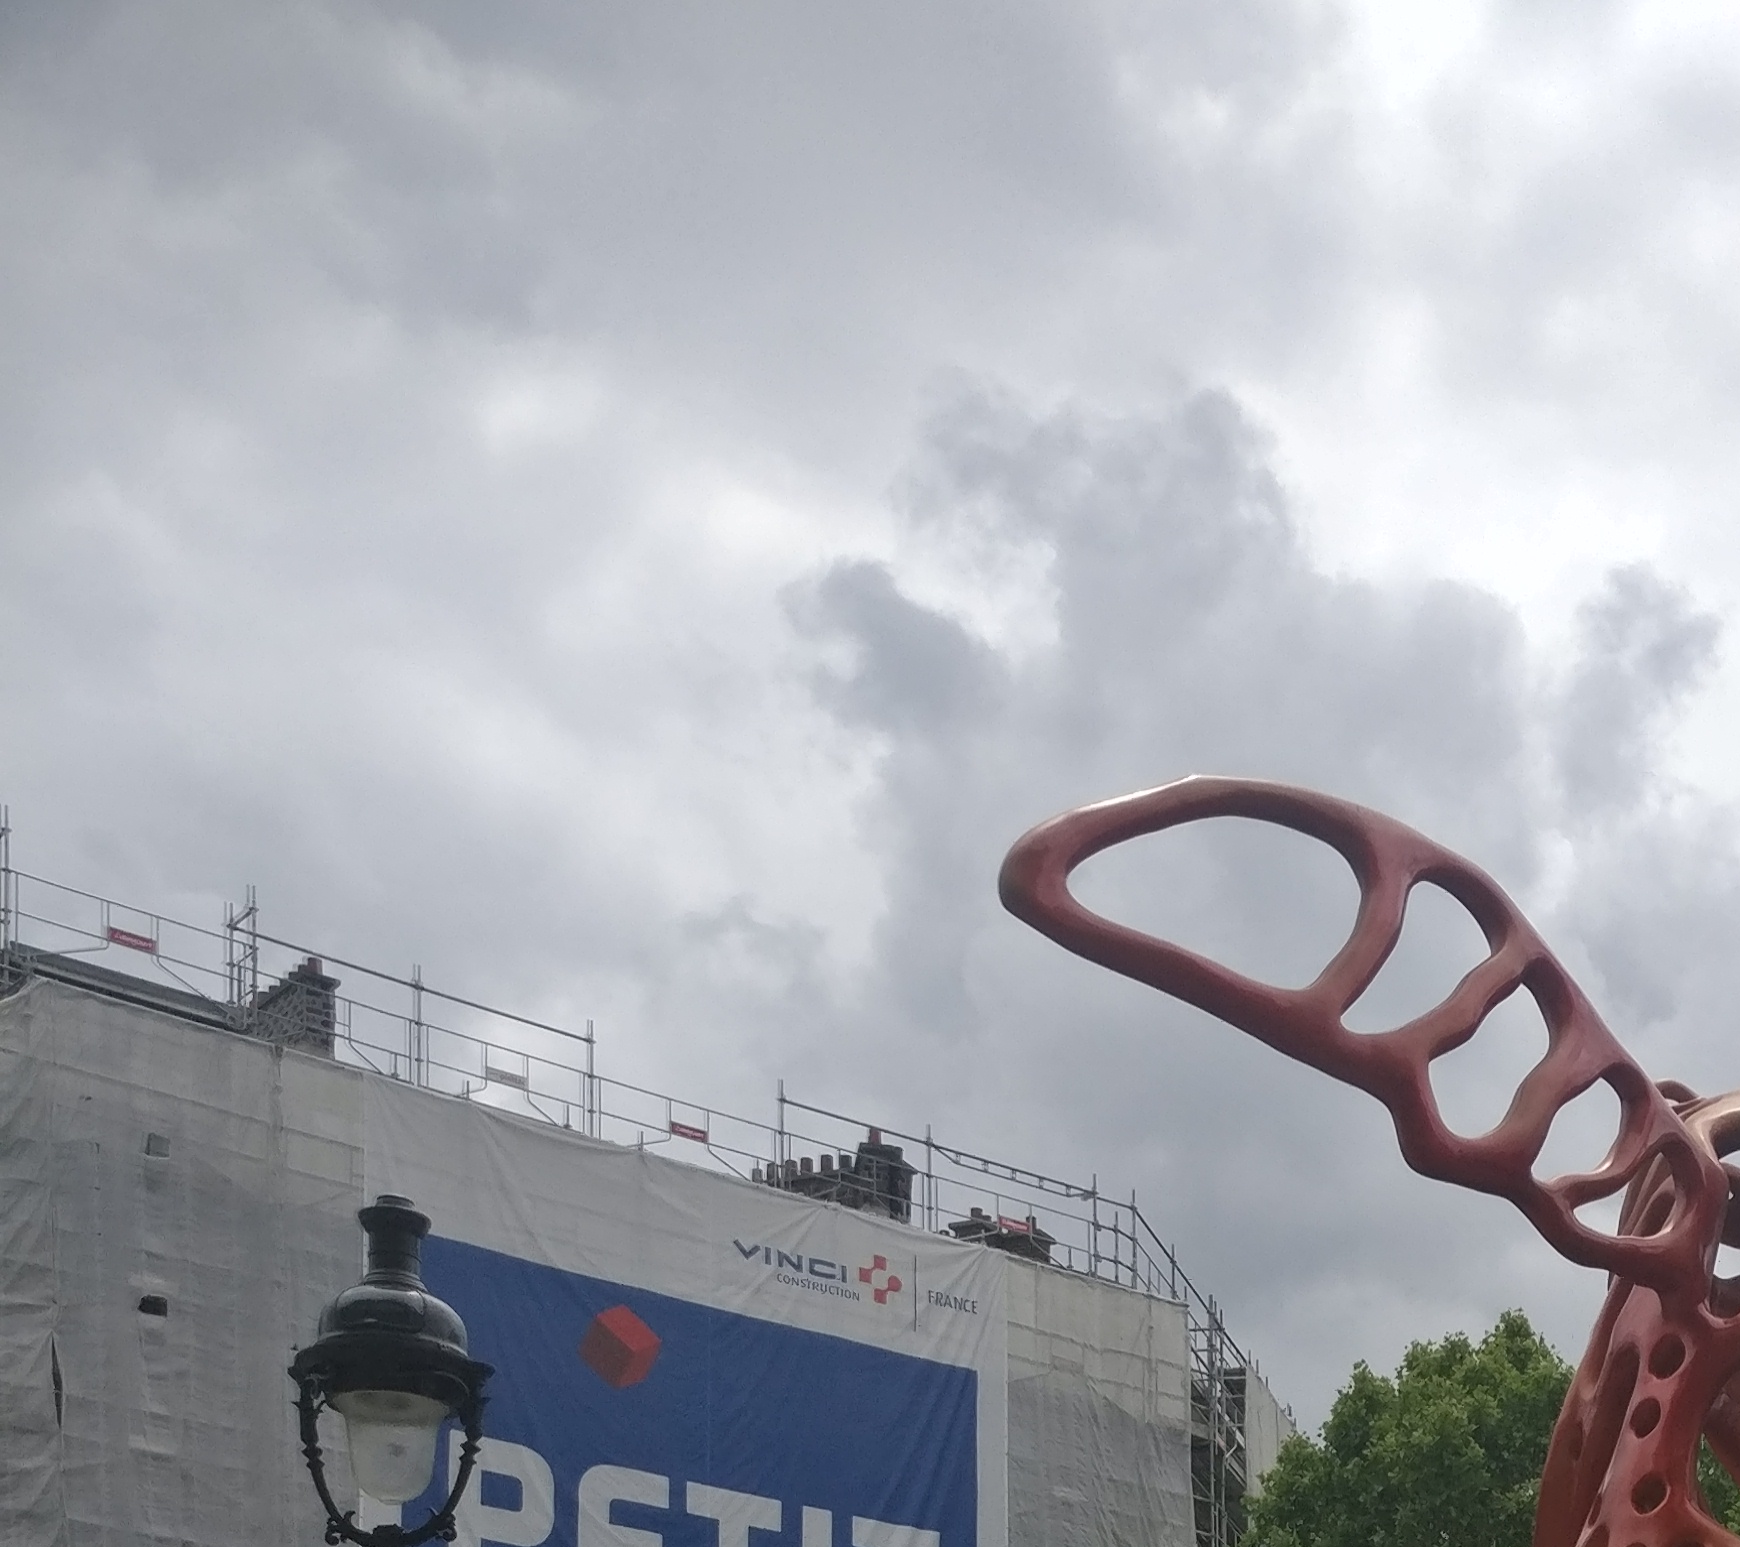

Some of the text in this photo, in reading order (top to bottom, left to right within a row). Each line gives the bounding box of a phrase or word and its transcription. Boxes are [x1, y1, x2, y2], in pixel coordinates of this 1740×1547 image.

[733, 1239, 847, 1283] VINCI
[777, 1273, 860, 1301] CONSTRUCTION
[928, 1290, 978, 1314] FRANCE
